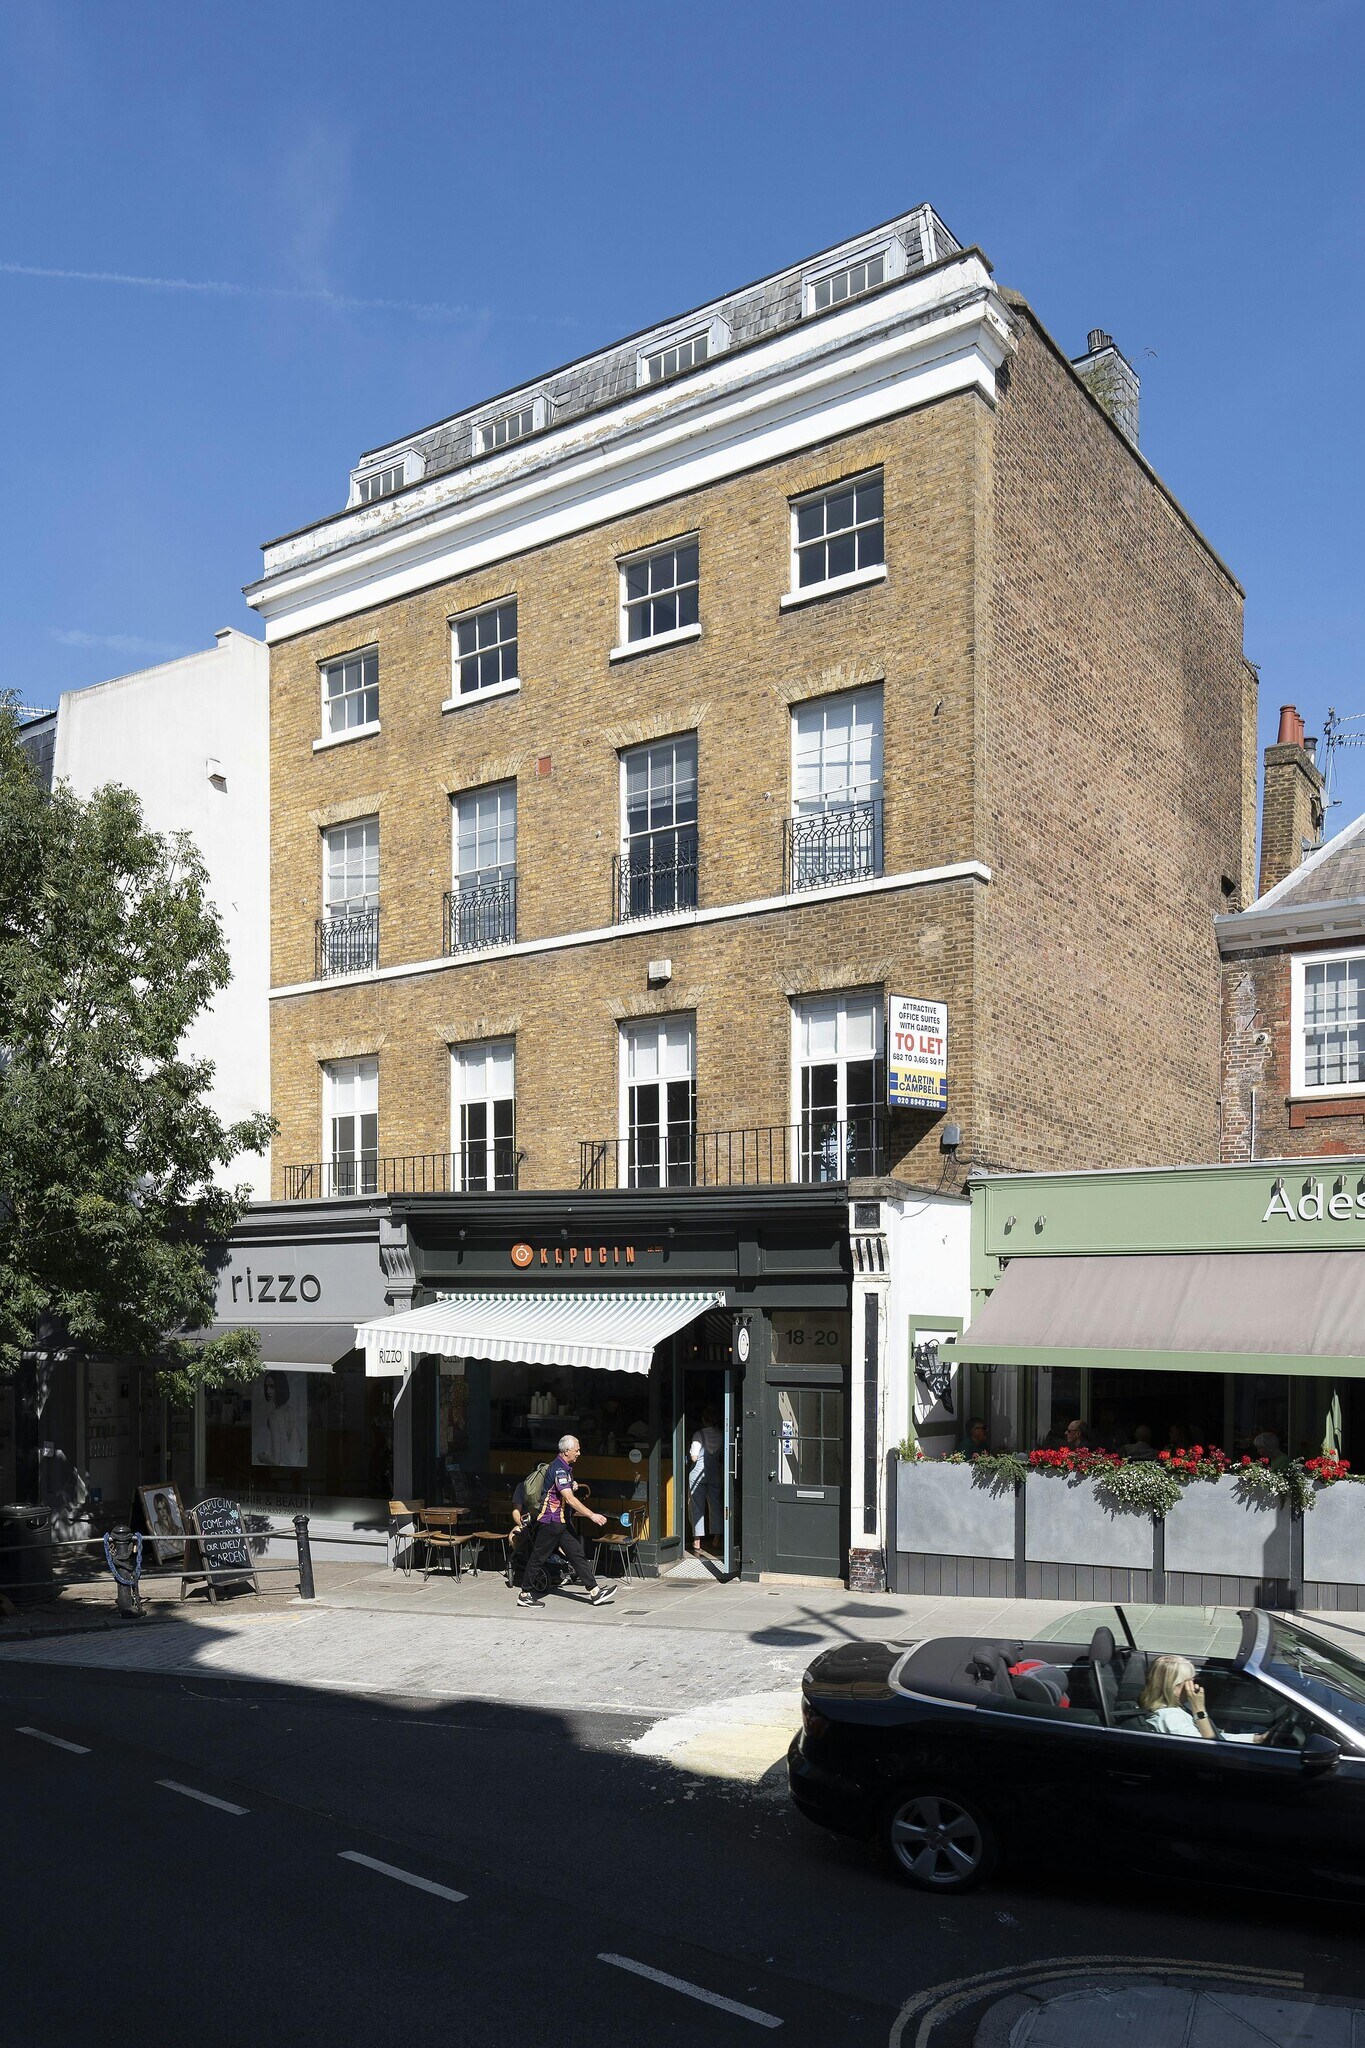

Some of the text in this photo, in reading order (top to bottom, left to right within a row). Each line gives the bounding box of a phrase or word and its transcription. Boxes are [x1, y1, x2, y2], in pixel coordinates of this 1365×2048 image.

[902, 1003, 937, 1014] ATTRACTIVE
[898, 1012, 941, 1025] OFFICE SUITES
[900, 1022, 940, 1034] WITH GARDEN
[895, 1032, 943, 1055] TO LET
[893, 1053, 903, 1061] 682
[904, 1054, 913, 1062] TO
[904, 1073, 935, 1085] MARTIN
[899, 1082, 939, 1095] CAMPBELL
[897, 1096, 909, 1105] 020
[540, 1246, 636, 1264] KAPUCIN
[232, 1267, 321, 1303] rizzo
[786, 1330, 839, 1345] 18-20
[379, 1350, 402, 1363] RIZZO
[197, 1500, 232, 1515] KAPUCIN
[239, 1495, 315, 1509] HAIR & BEAUTY
[202, 1517, 237, 1530] COME AND
[206, 1538, 241, 1551] OUR LOVELY
[209, 1550, 246, 1567] GARDEN
